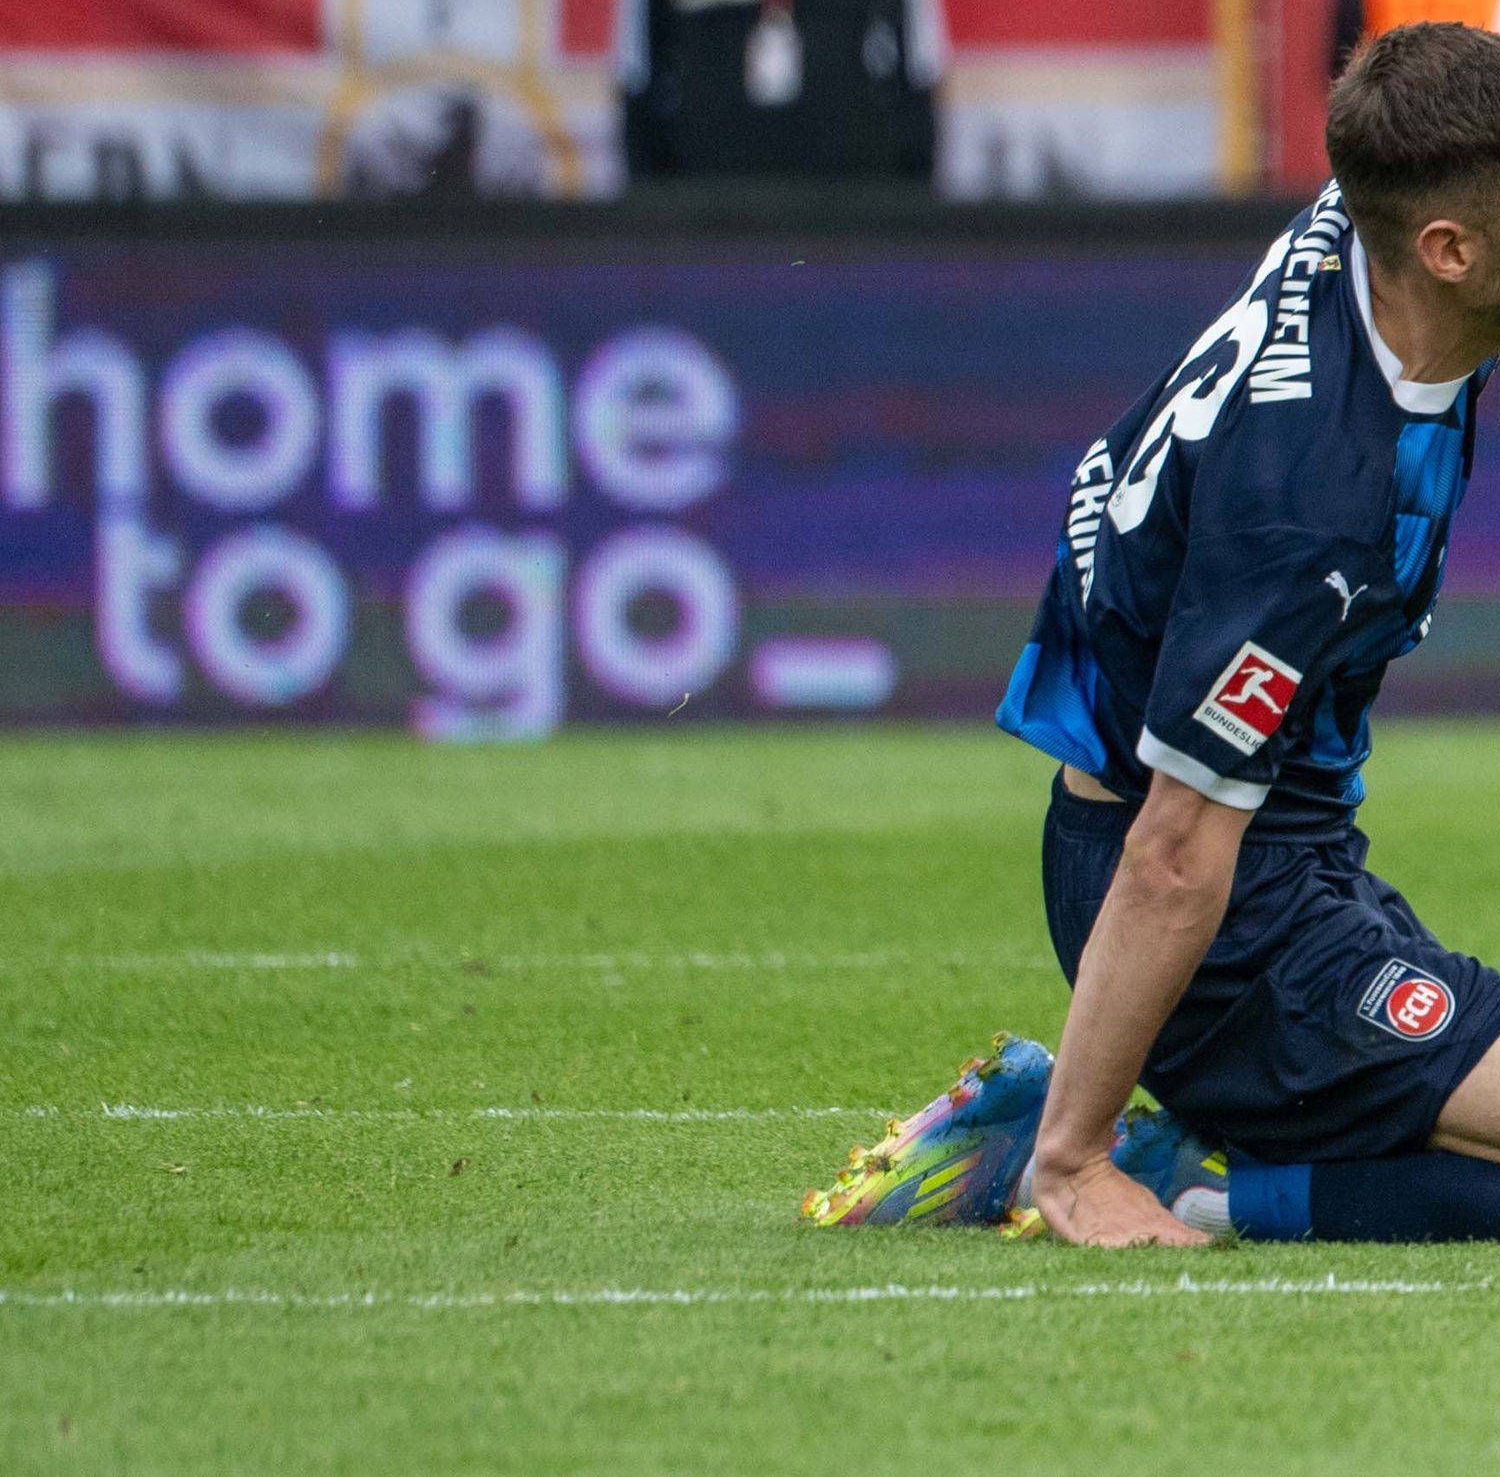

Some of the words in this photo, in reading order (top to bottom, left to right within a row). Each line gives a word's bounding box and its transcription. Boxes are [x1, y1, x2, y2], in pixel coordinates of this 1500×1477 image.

[0, 256, 741, 513] home
[1250, 178, 1352, 404] EIDENEIM
[97, 513, 350, 707] to
[1397, 984, 1439, 1029] FCH
